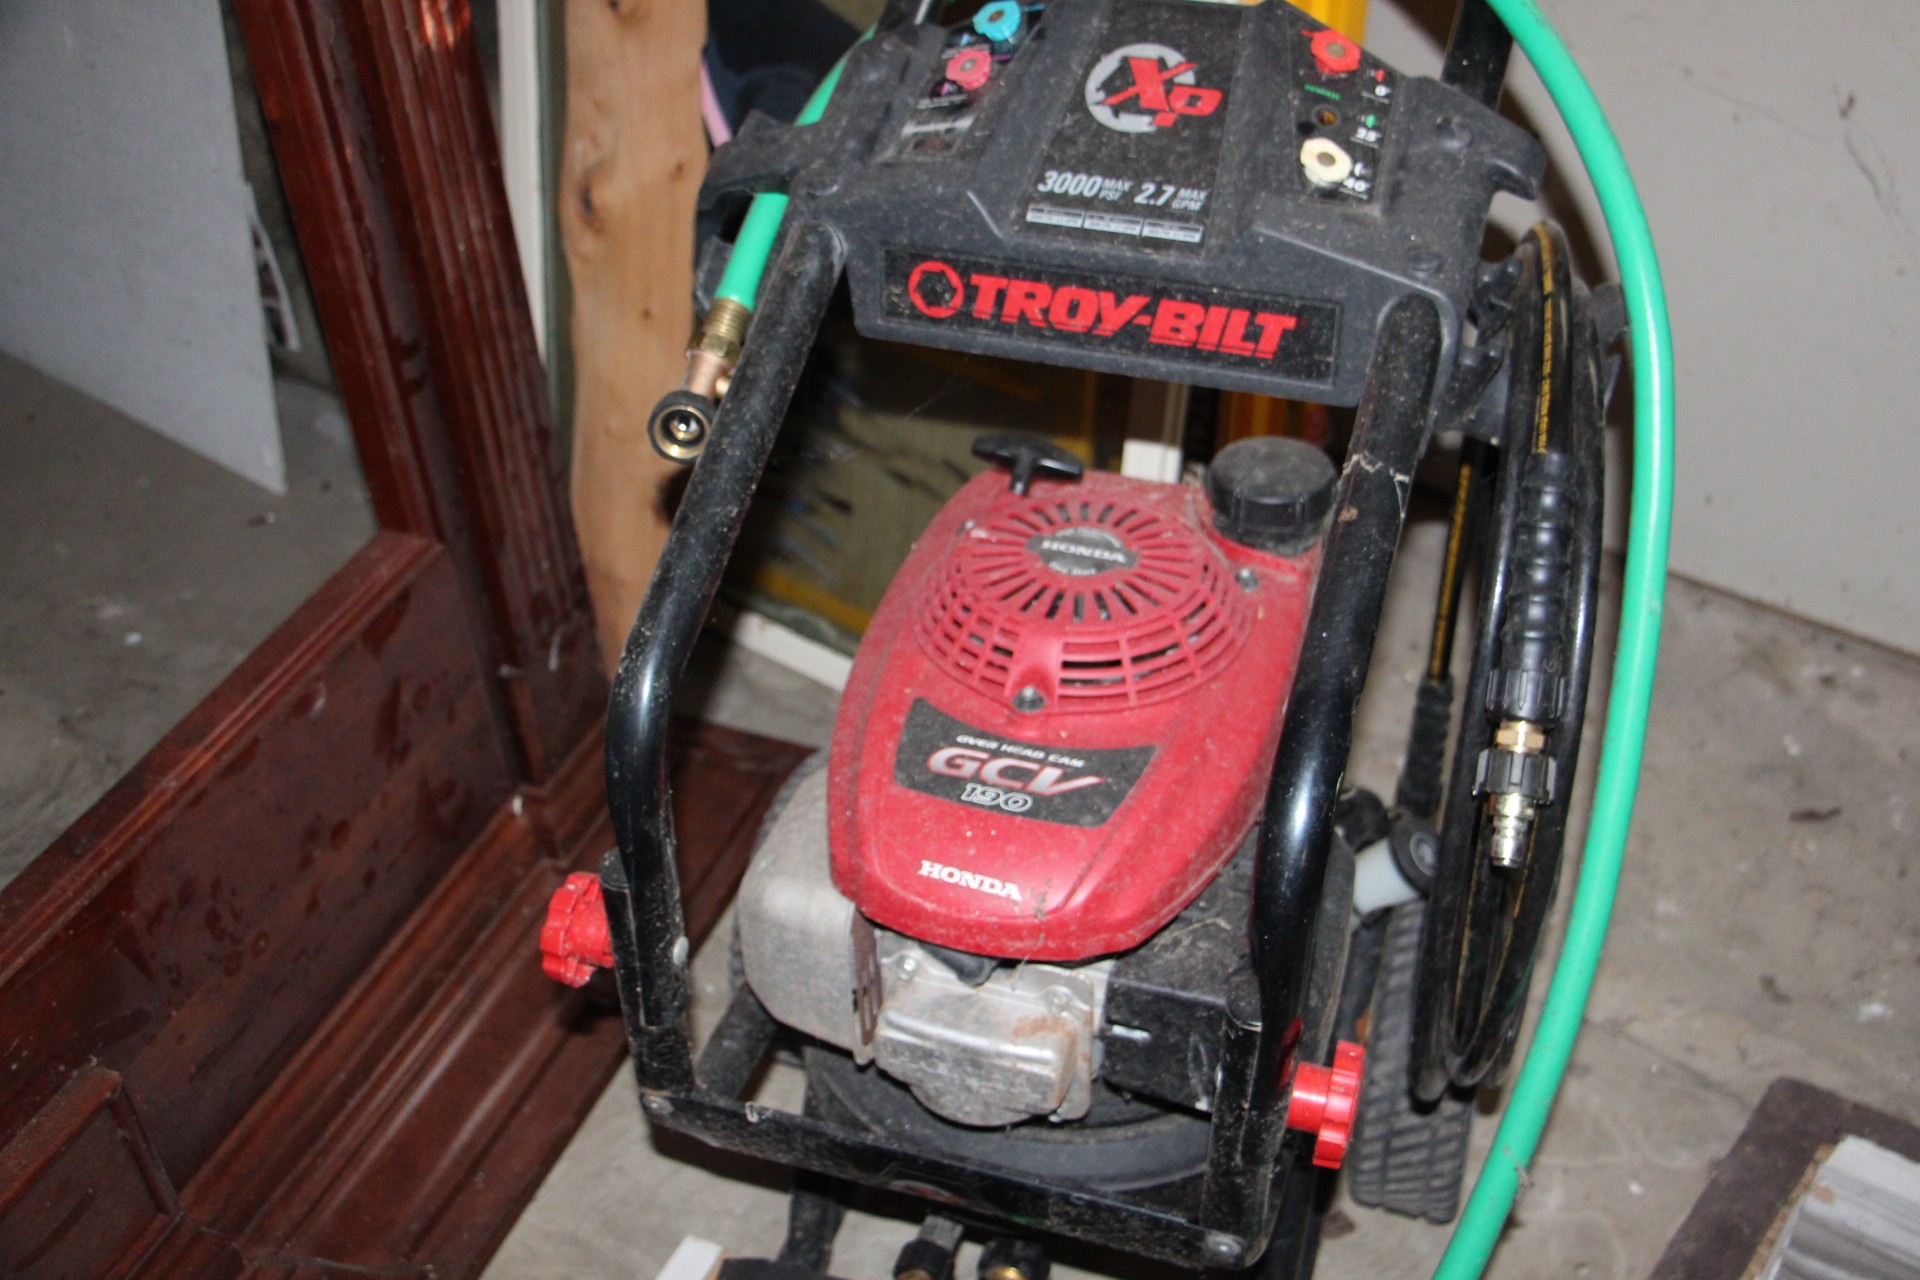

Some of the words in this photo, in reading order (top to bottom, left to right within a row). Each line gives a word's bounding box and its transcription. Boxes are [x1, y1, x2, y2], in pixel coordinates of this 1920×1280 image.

[1037, 169, 1103, 198] 3000
[1133, 181, 1176, 207] 2.7
[1098, 189, 1122, 202] PSI
[1101, 177, 1133, 193] MAX
[1177, 187, 1208, 201] MAX
[1171, 199, 1204, 212] GPM
[969, 272, 1298, 360] TROY-BILT
[1041, 540, 1127, 565] HONDA
[956, 734, 1000, 750] OVER
[1000, 743, 1046, 760] HEAD
[1047, 753, 1086, 769] CAM
[929, 746, 1105, 796] GCV
[960, 782, 1034, 813] 190
[918, 859, 1023, 901] HONDA
